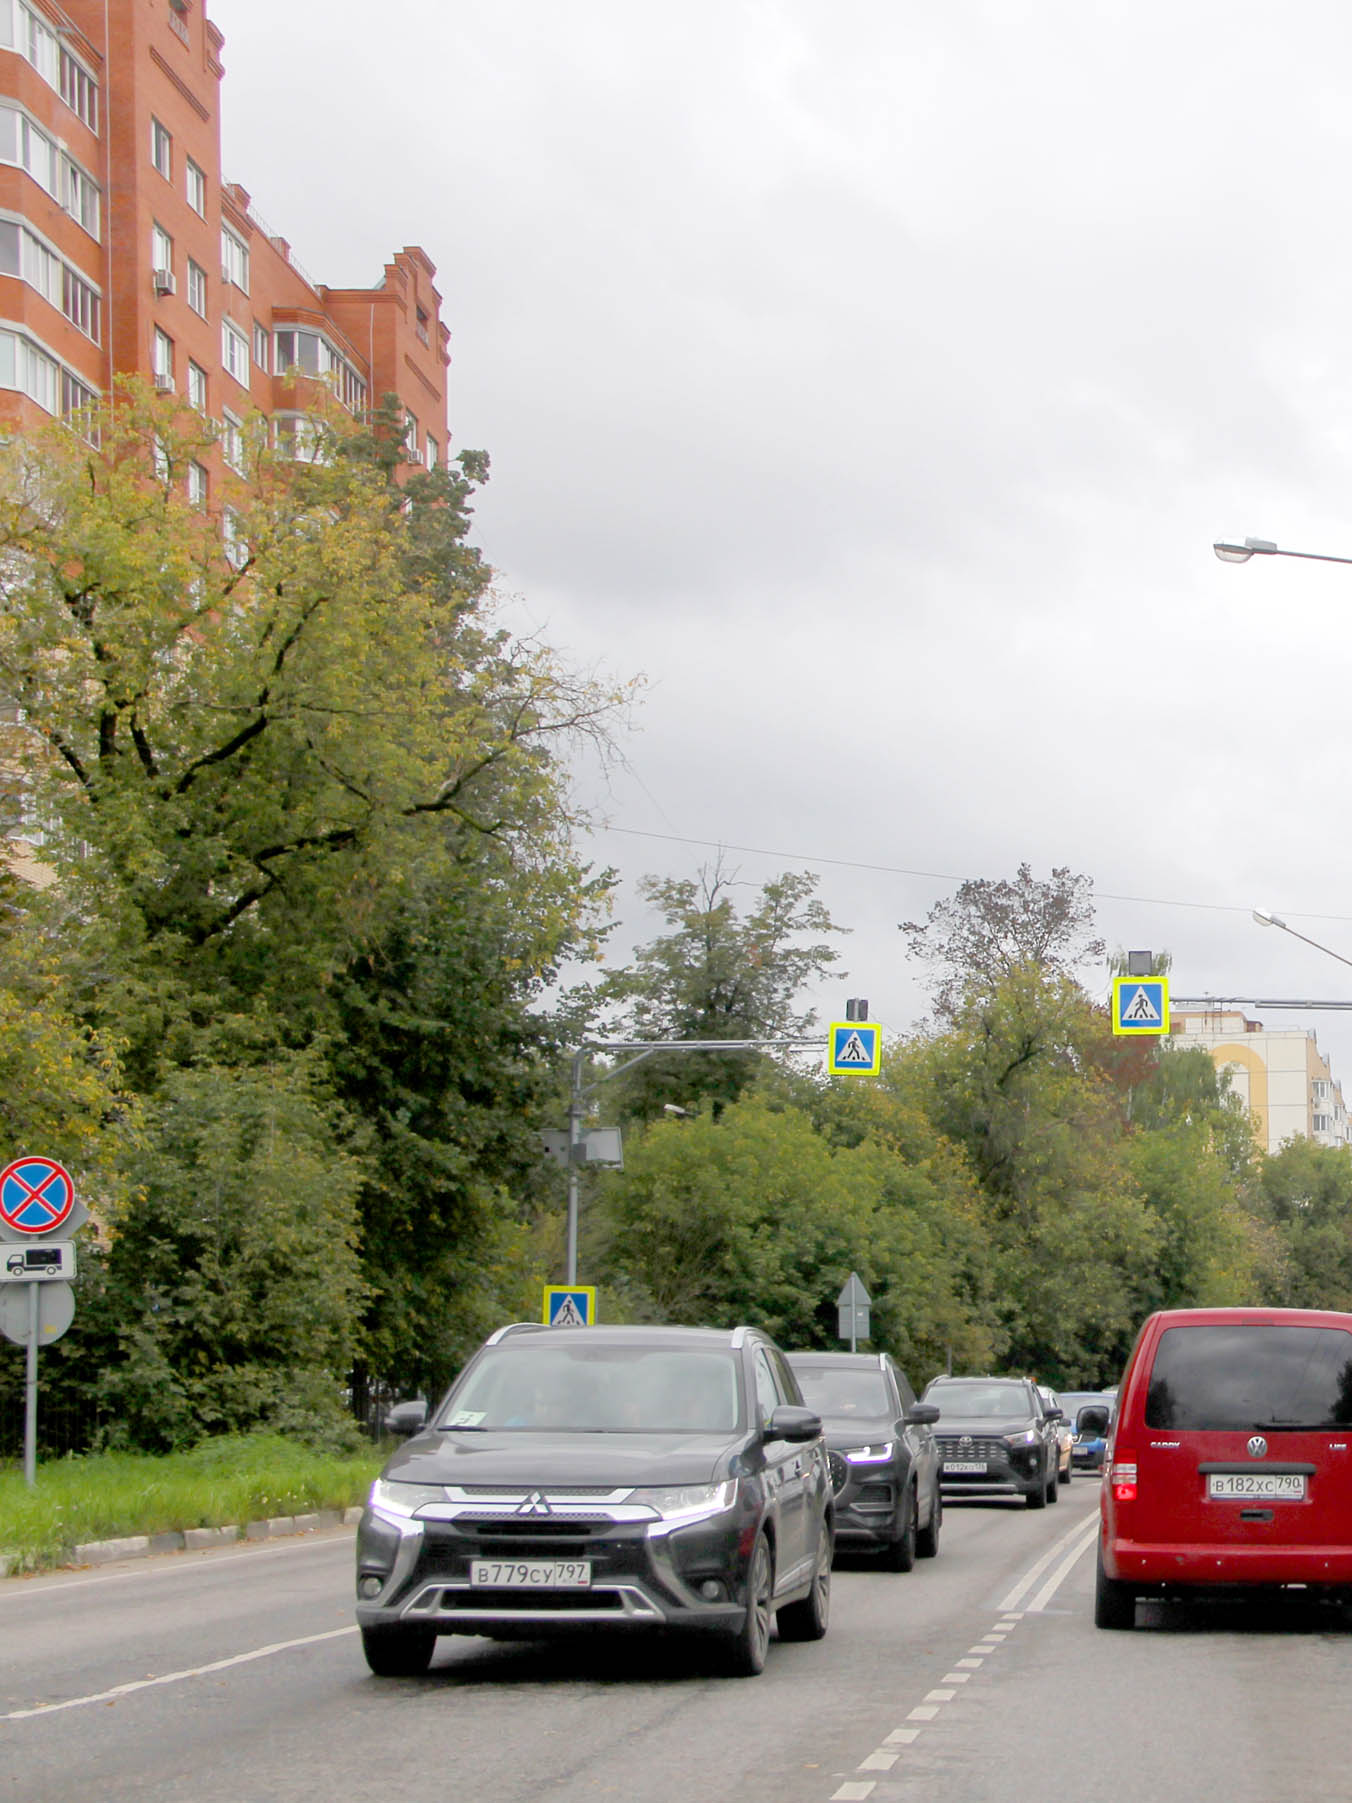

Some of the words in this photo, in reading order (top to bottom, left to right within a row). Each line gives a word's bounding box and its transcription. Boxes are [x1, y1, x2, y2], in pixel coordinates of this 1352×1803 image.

[1215, 1477, 1274, 1492] В182ХС
[1277, 1477, 1300, 1489] 790
[478, 1564, 553, 1583] В779СУ
[557, 1564, 585, 1578] 797
